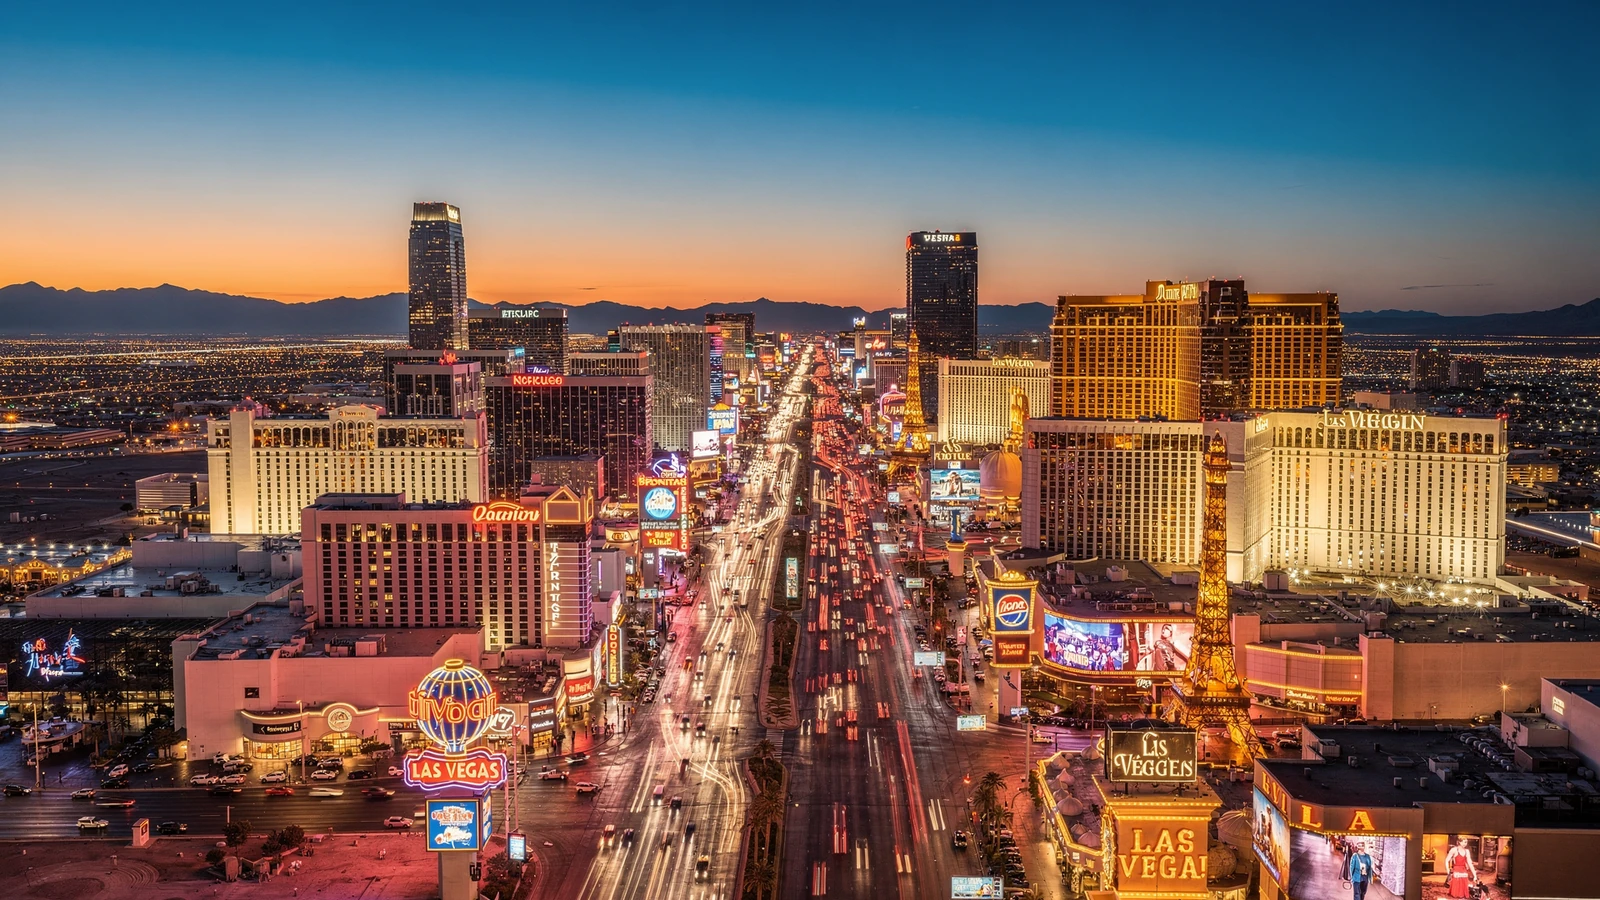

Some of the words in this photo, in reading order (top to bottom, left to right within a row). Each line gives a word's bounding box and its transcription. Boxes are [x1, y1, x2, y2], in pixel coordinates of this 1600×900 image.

[412, 762, 441, 780] LAS
[446, 761, 500, 780] VEGAS
[1130, 828, 1196, 855] LAS
